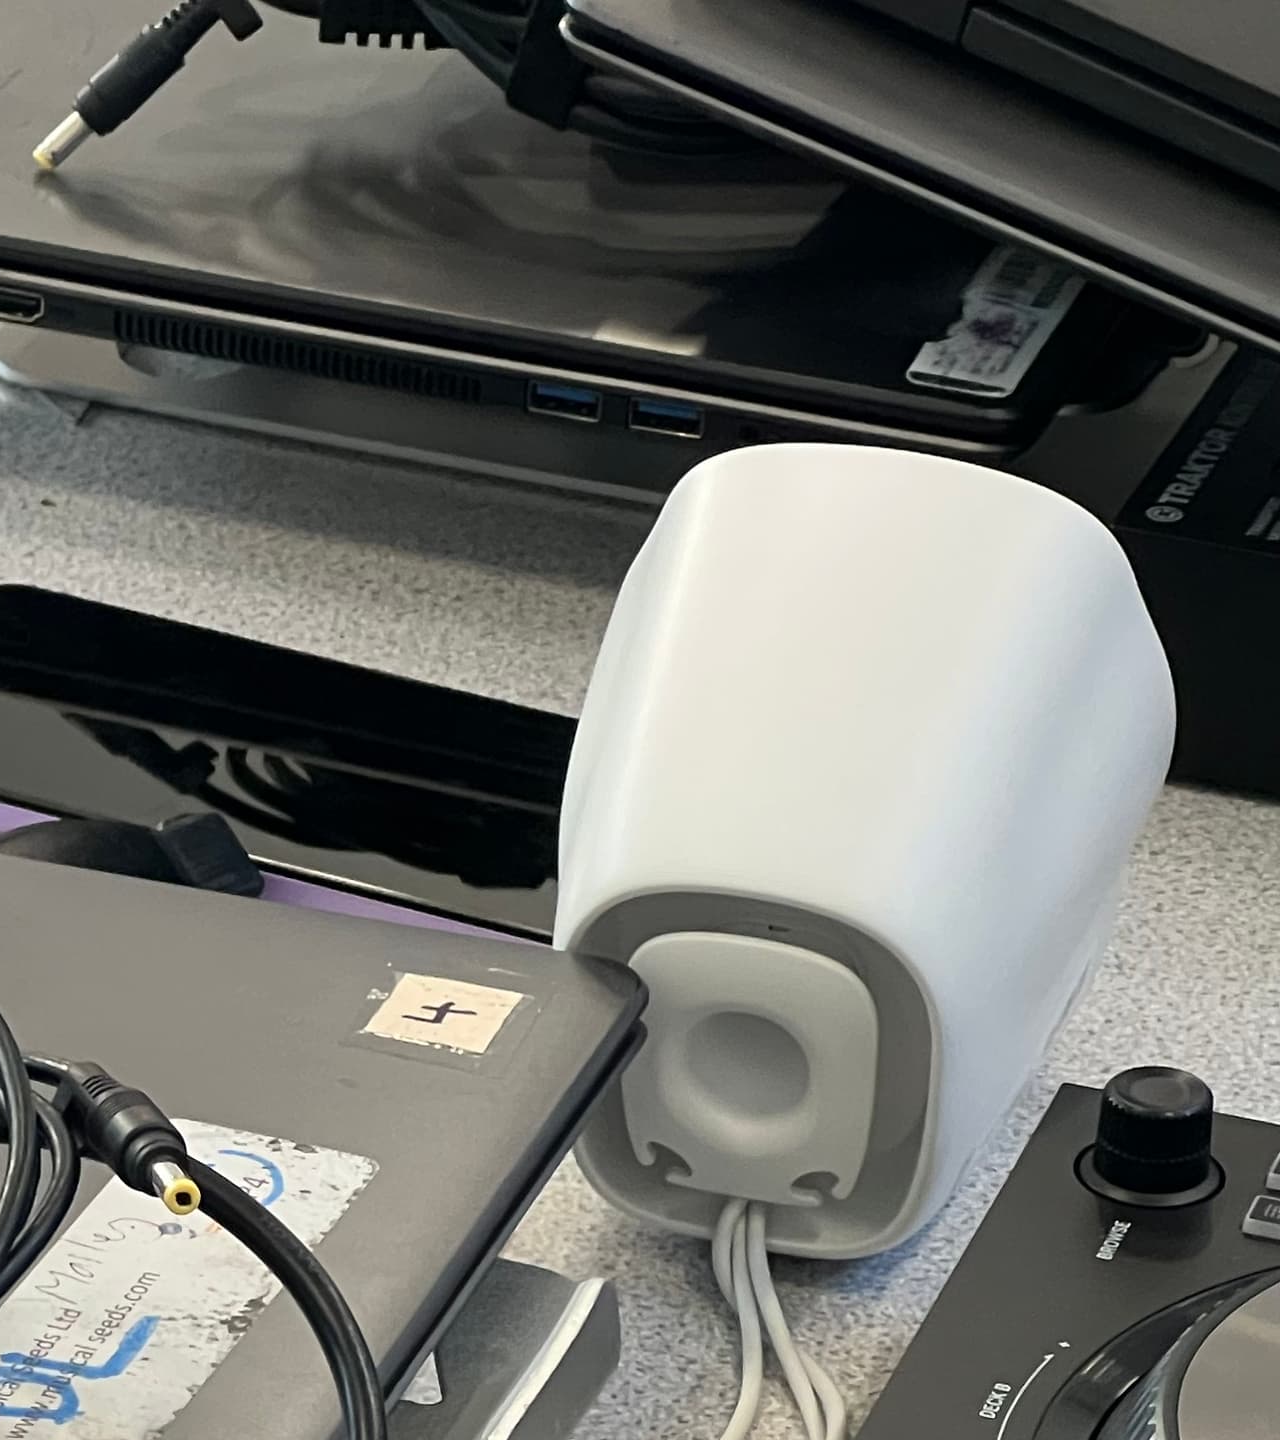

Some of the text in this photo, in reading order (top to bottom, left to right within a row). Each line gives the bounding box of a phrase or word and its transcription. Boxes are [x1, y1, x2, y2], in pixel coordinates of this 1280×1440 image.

[1158, 427, 1238, 503] TRAKTOR
[1095, 1220, 1133, 1261] BROWSE
[10, 1331, 62, 1375] Seeds
[47, 1307, 82, 1338] Ltd
[978, 1390, 1008, 1419] DECK
